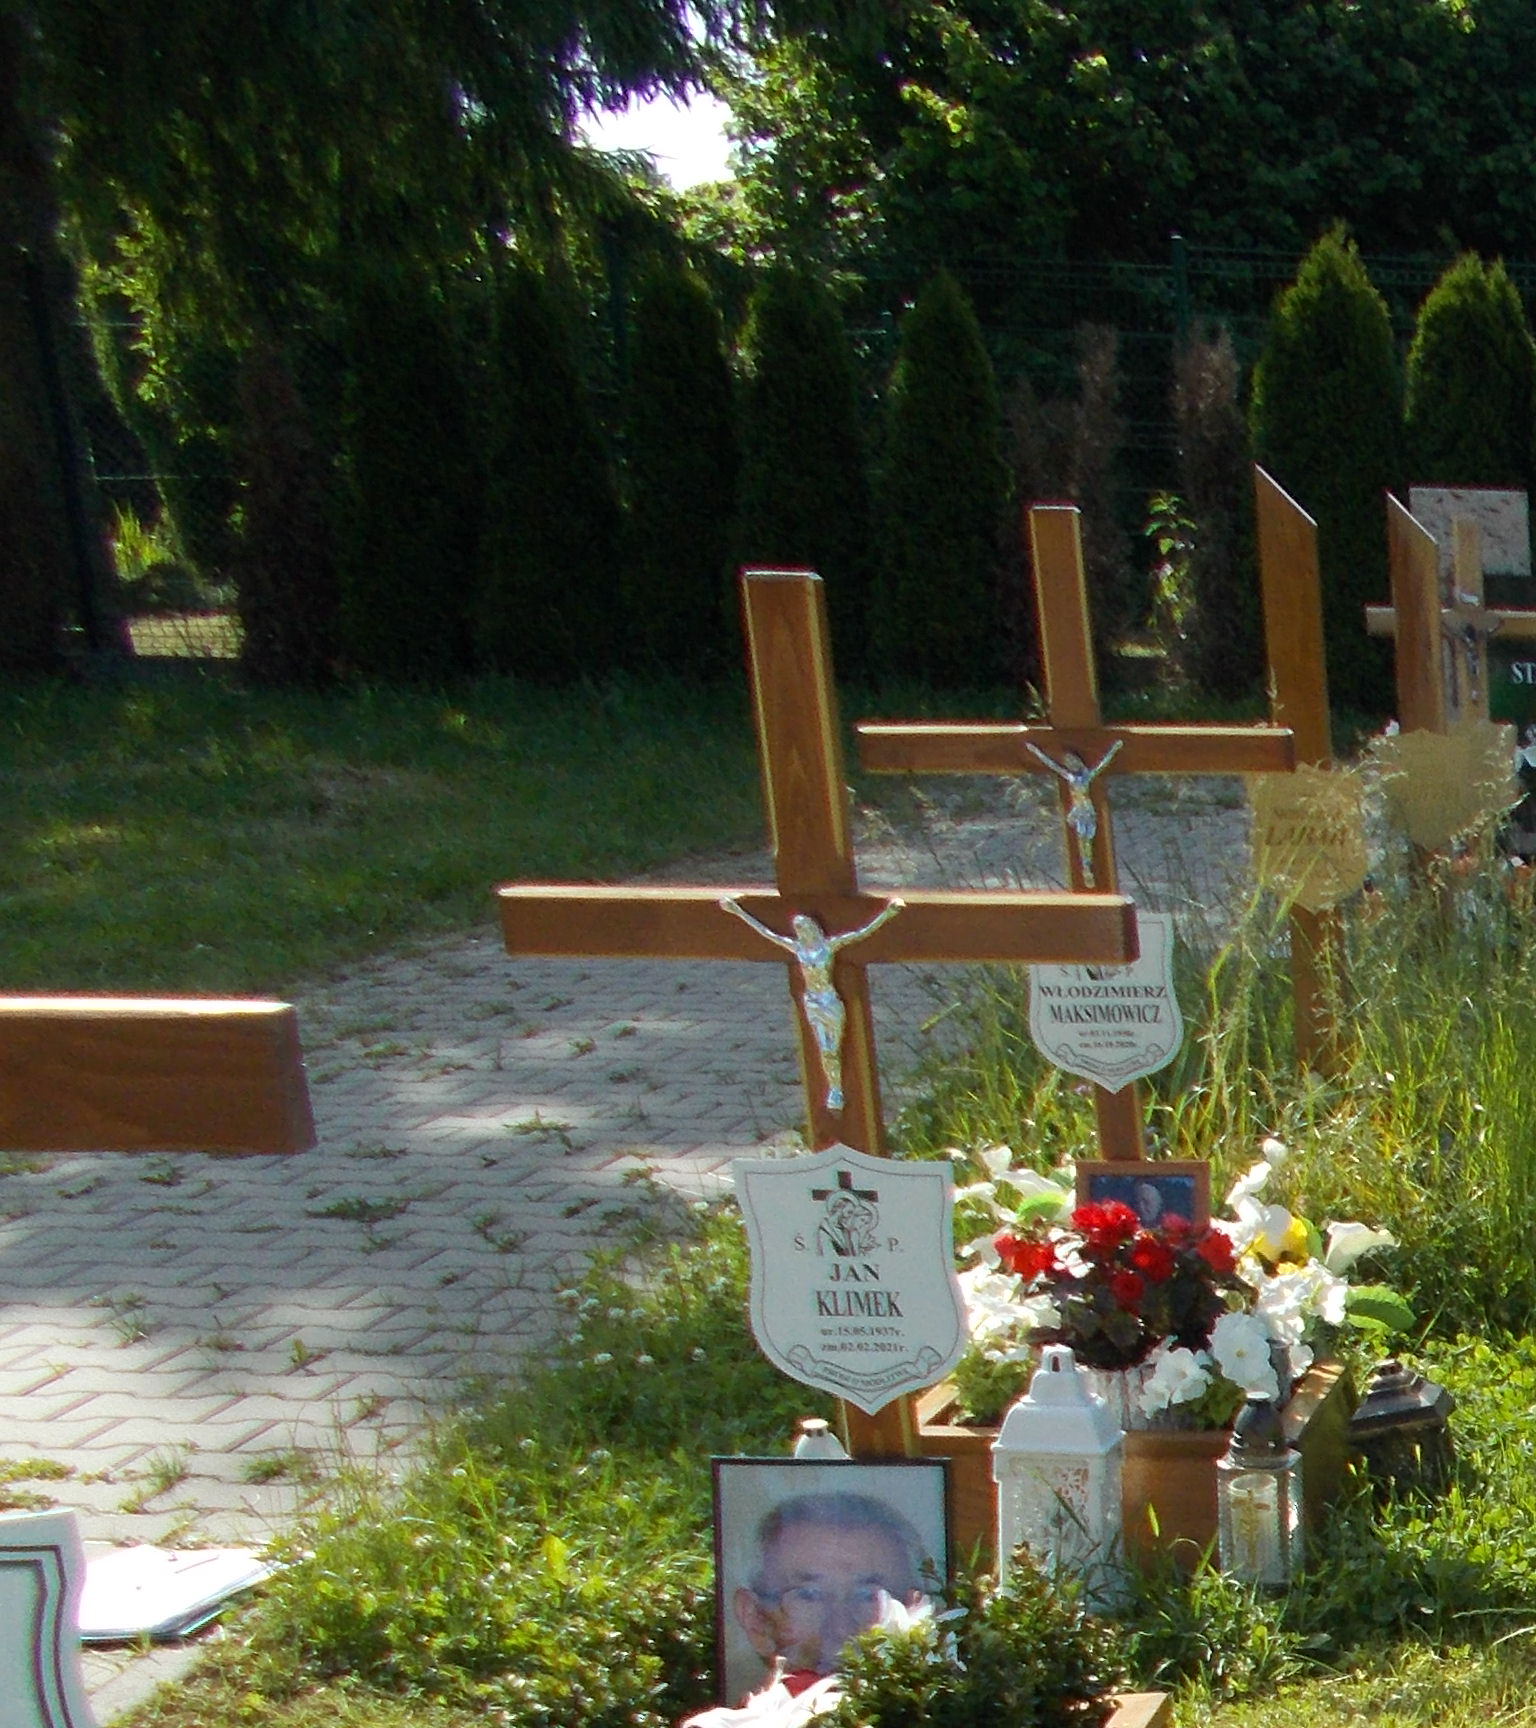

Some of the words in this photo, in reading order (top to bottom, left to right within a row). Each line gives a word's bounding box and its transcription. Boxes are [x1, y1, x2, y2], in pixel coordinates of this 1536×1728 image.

[1040, 984, 1168, 999] WŁODZIMIERZ
[1049, 1003, 1163, 1025] MAKSIMOWICZ
[829, 1263, 881, 1282] JAN
[815, 1290, 904, 1318] KLIMEK
